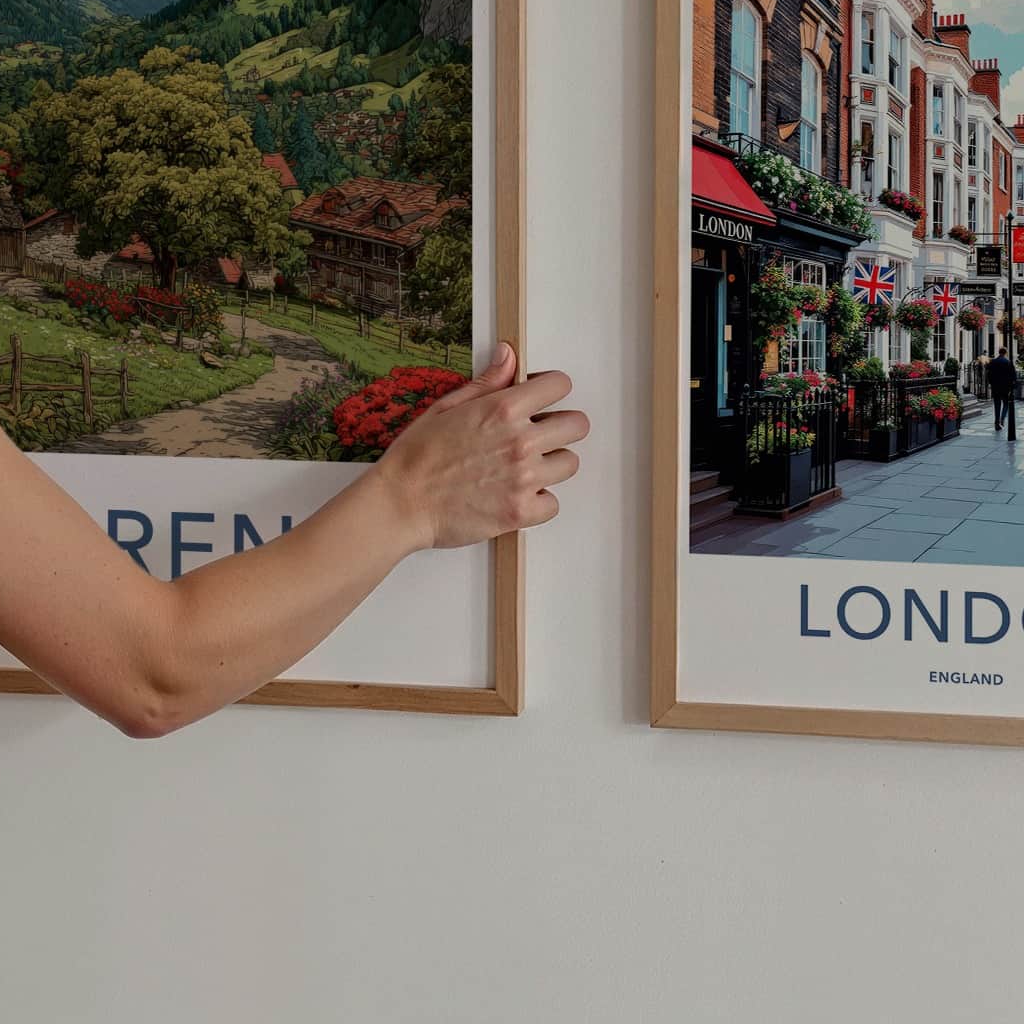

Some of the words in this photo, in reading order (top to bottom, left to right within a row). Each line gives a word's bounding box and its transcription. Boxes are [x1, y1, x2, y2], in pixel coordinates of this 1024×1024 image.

[699, 213, 753, 242] LONDON
[799, 583, 1024, 645] LOND
[928, 670, 1004, 686] ENGLAND
